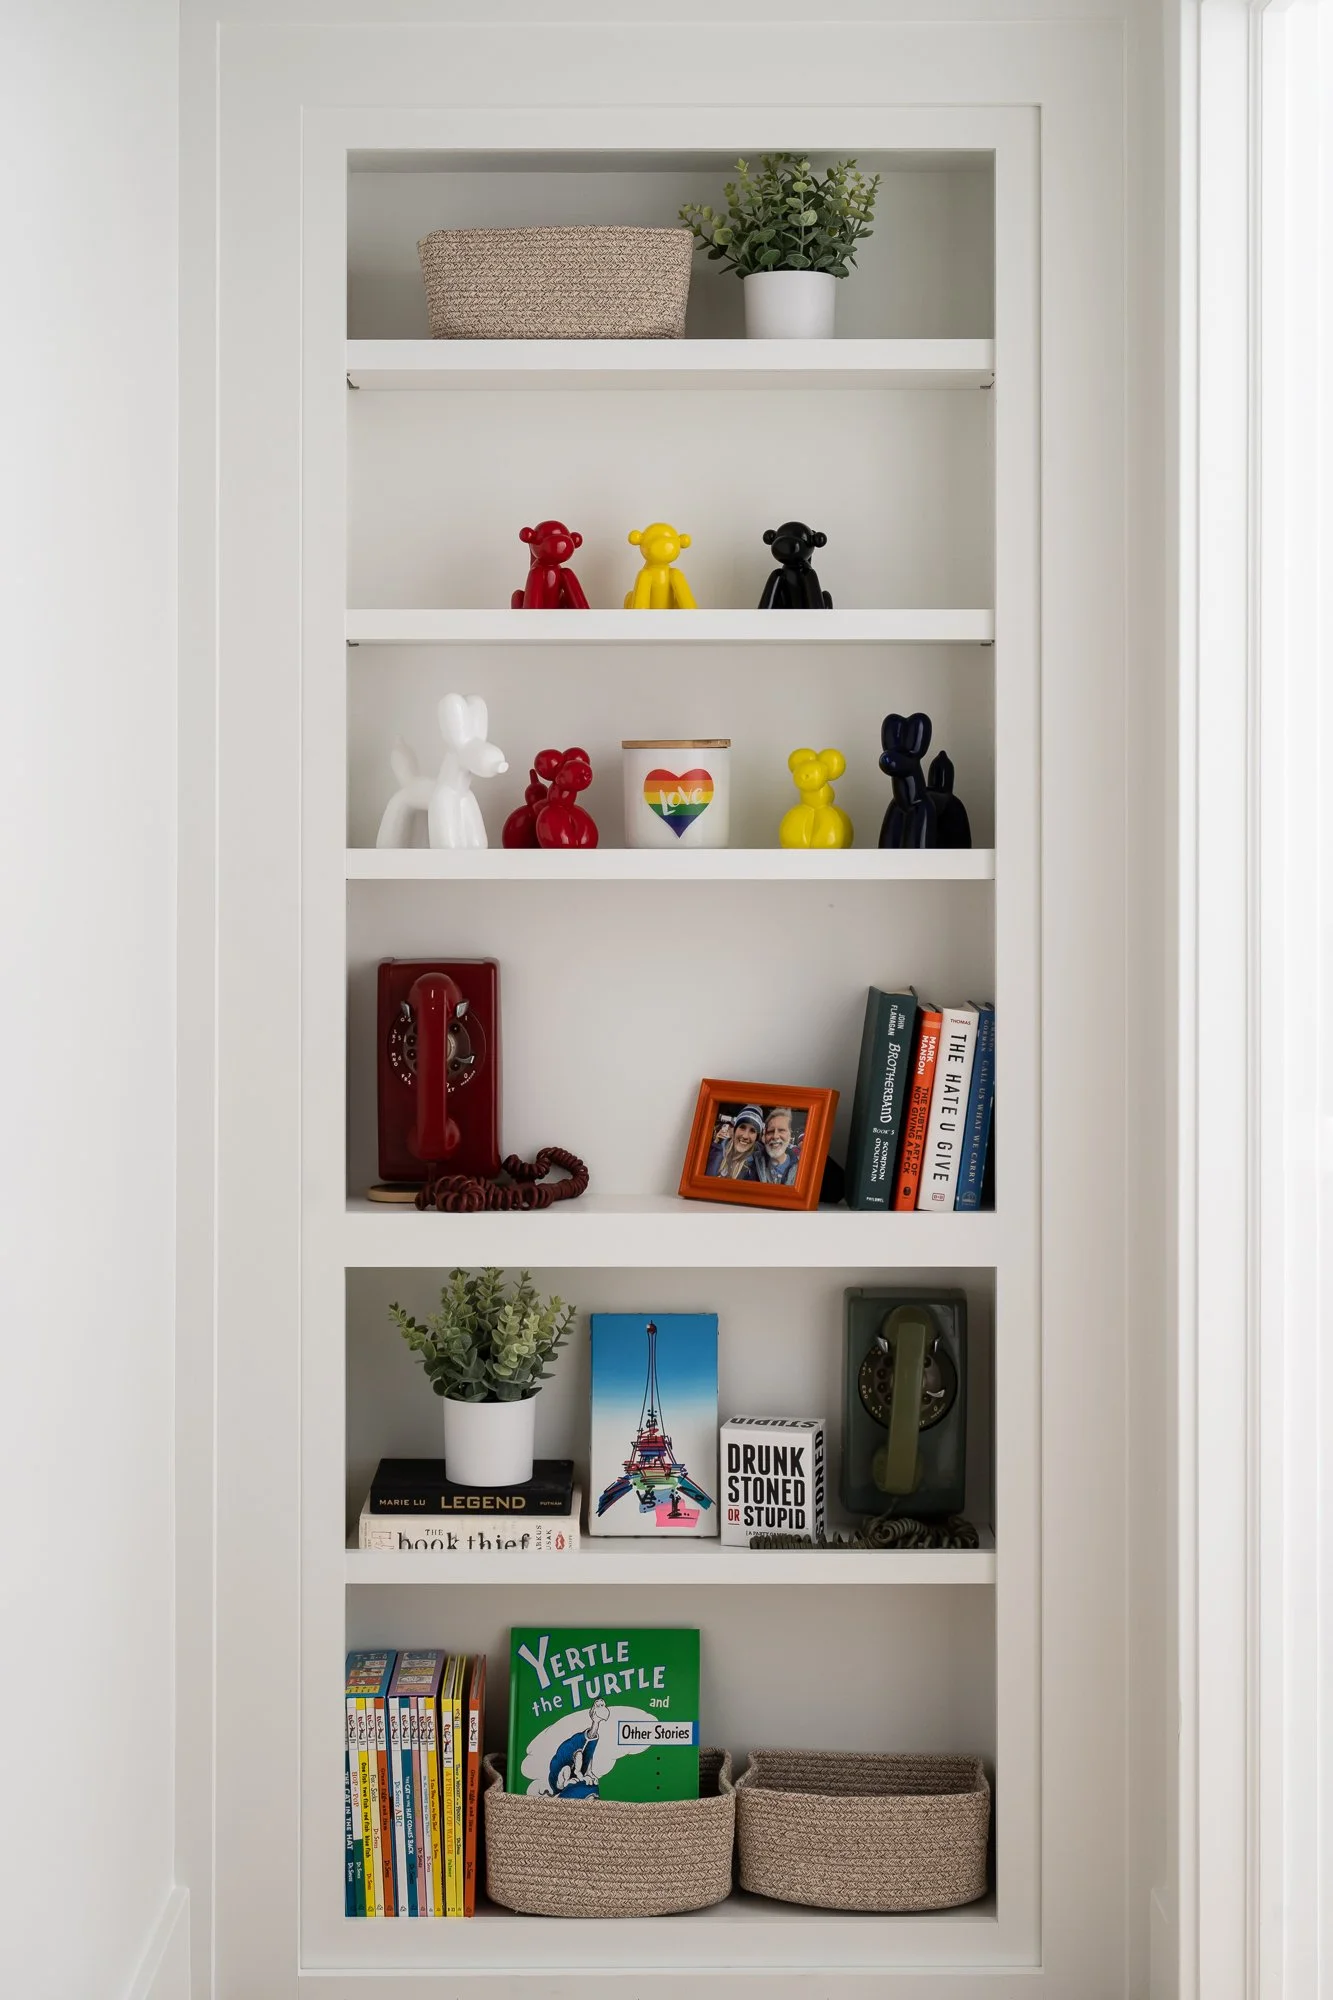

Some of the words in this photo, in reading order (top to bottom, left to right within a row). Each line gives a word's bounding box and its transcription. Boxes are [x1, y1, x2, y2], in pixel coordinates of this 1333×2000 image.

[660, 786, 704, 816] LOVE
[887, 1005, 898, 1036] FLANAGAN
[917, 1035, 929, 1075] MANSON
[926, 1036, 937, 1063] MARK
[948, 1035, 967, 1063] THE
[880, 1042, 901, 1123] BROTHERBAND
[981, 1060, 989, 1083] CALL
[912, 1086, 922, 1104] NOT
[921, 1087, 930, 1104] THE
[942, 1074, 962, 1115] HATE
[978, 1088, 986, 1099] US
[908, 1107, 920, 1139] GIVING
[915, 1106, 927, 1140] SUBTLE
[940, 1123, 956, 1131] U
[975, 1104, 985, 1130] WHAT
[912, 1142, 922, 1160] ART
[972, 1135, 981, 1149] WE
[871, 1138, 882, 1182] MOUNTAIN
[879, 1141, 889, 1180] SCORPION
[910, 1163, 919, 1177] OF
[933, 1142, 953, 1181] GIVE
[968, 1153, 978, 1184] CARRY
[728, 1443, 805, 1477] DRUNK
[441, 1496, 526, 1509] LEGEND
[728, 1475, 805, 1507] STONED
[728, 1508, 740, 1522] OR
[744, 1506, 806, 1530] STUPID
[397, 1531, 459, 1549] book
[467, 1532, 531, 1549] thief
[518, 1636, 629, 1690] YERTLE
[532, 1695, 562, 1717] the
[562, 1666, 665, 1708] TURTLE
[650, 1696, 669, 1708] and
[622, 1724, 651, 1740] Other
[655, 1725, 690, 1740] Stories
[346, 1806, 351, 1814] IN
[395, 1808, 403, 1827] ABC
[447, 1817, 453, 1827] OF
